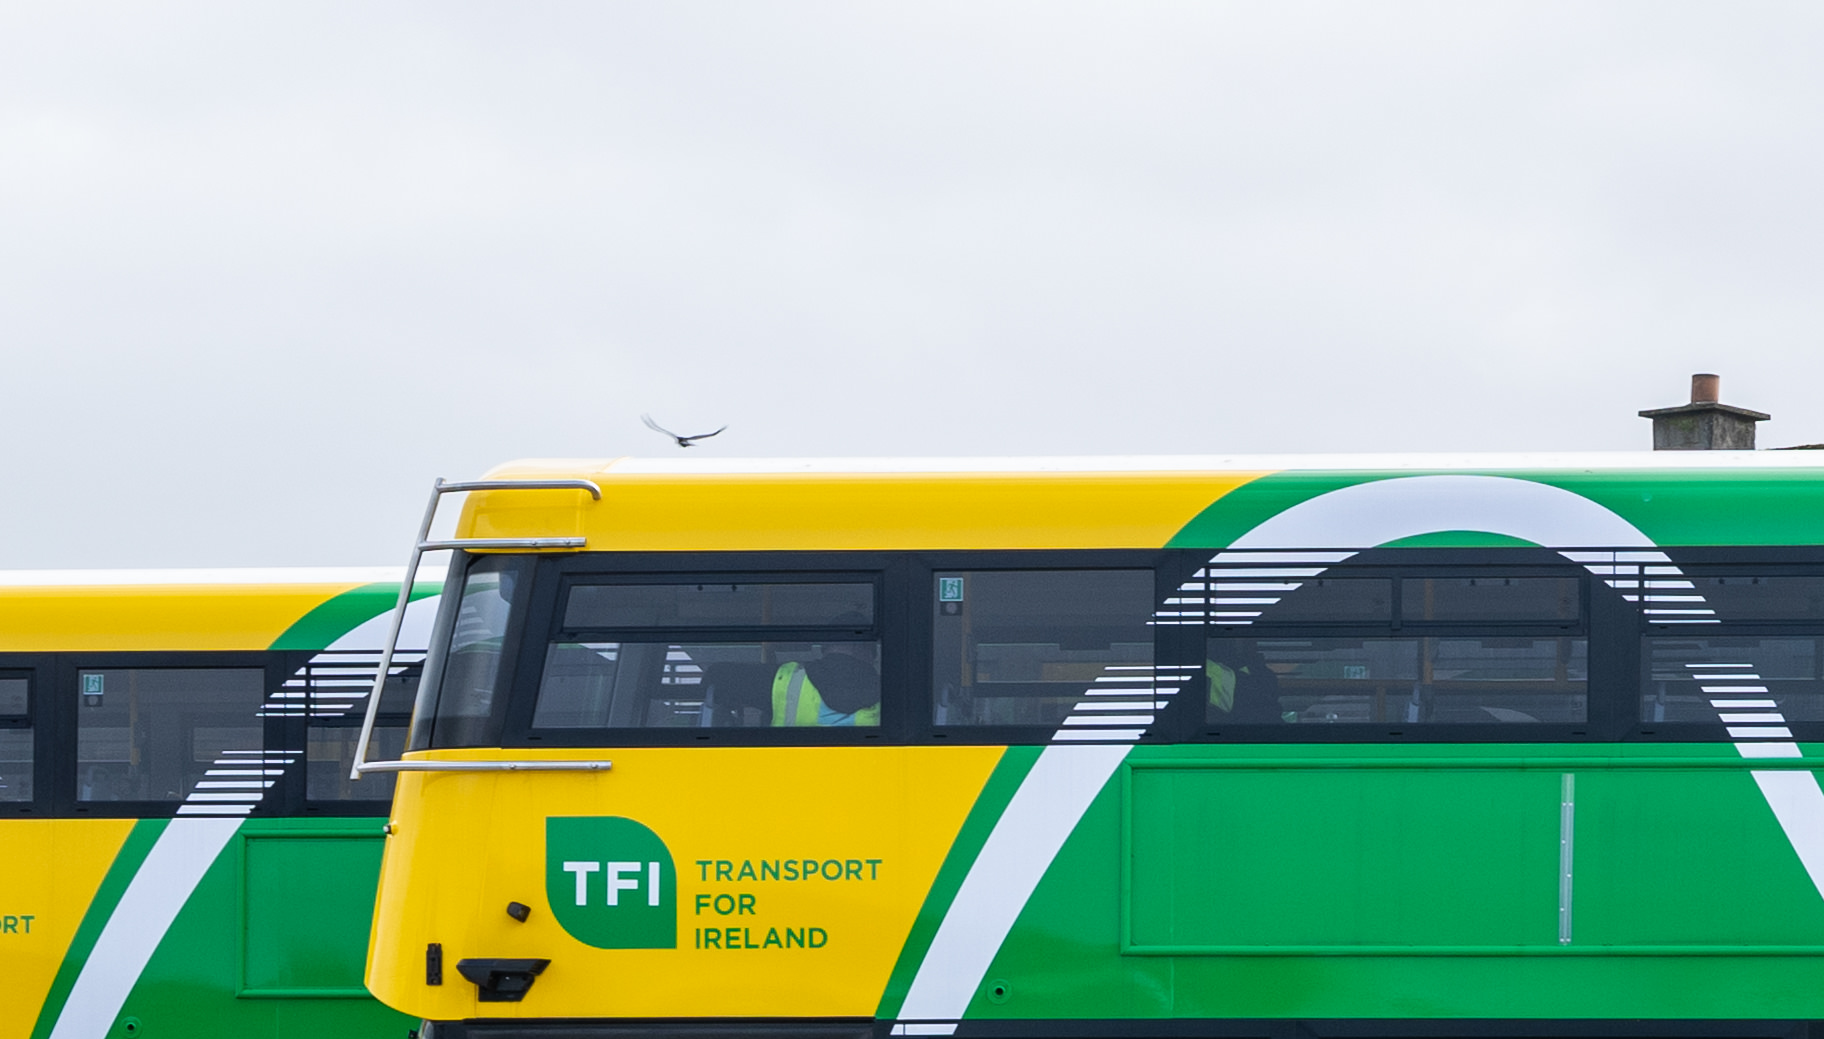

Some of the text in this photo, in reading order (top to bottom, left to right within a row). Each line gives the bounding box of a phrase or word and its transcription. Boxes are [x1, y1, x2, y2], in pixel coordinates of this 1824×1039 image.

[696, 860, 882, 881] TRANSPORT
[563, 862, 660, 906] TFI
[696, 894, 755, 915] FOR
[696, 928, 827, 949] IRELAND
